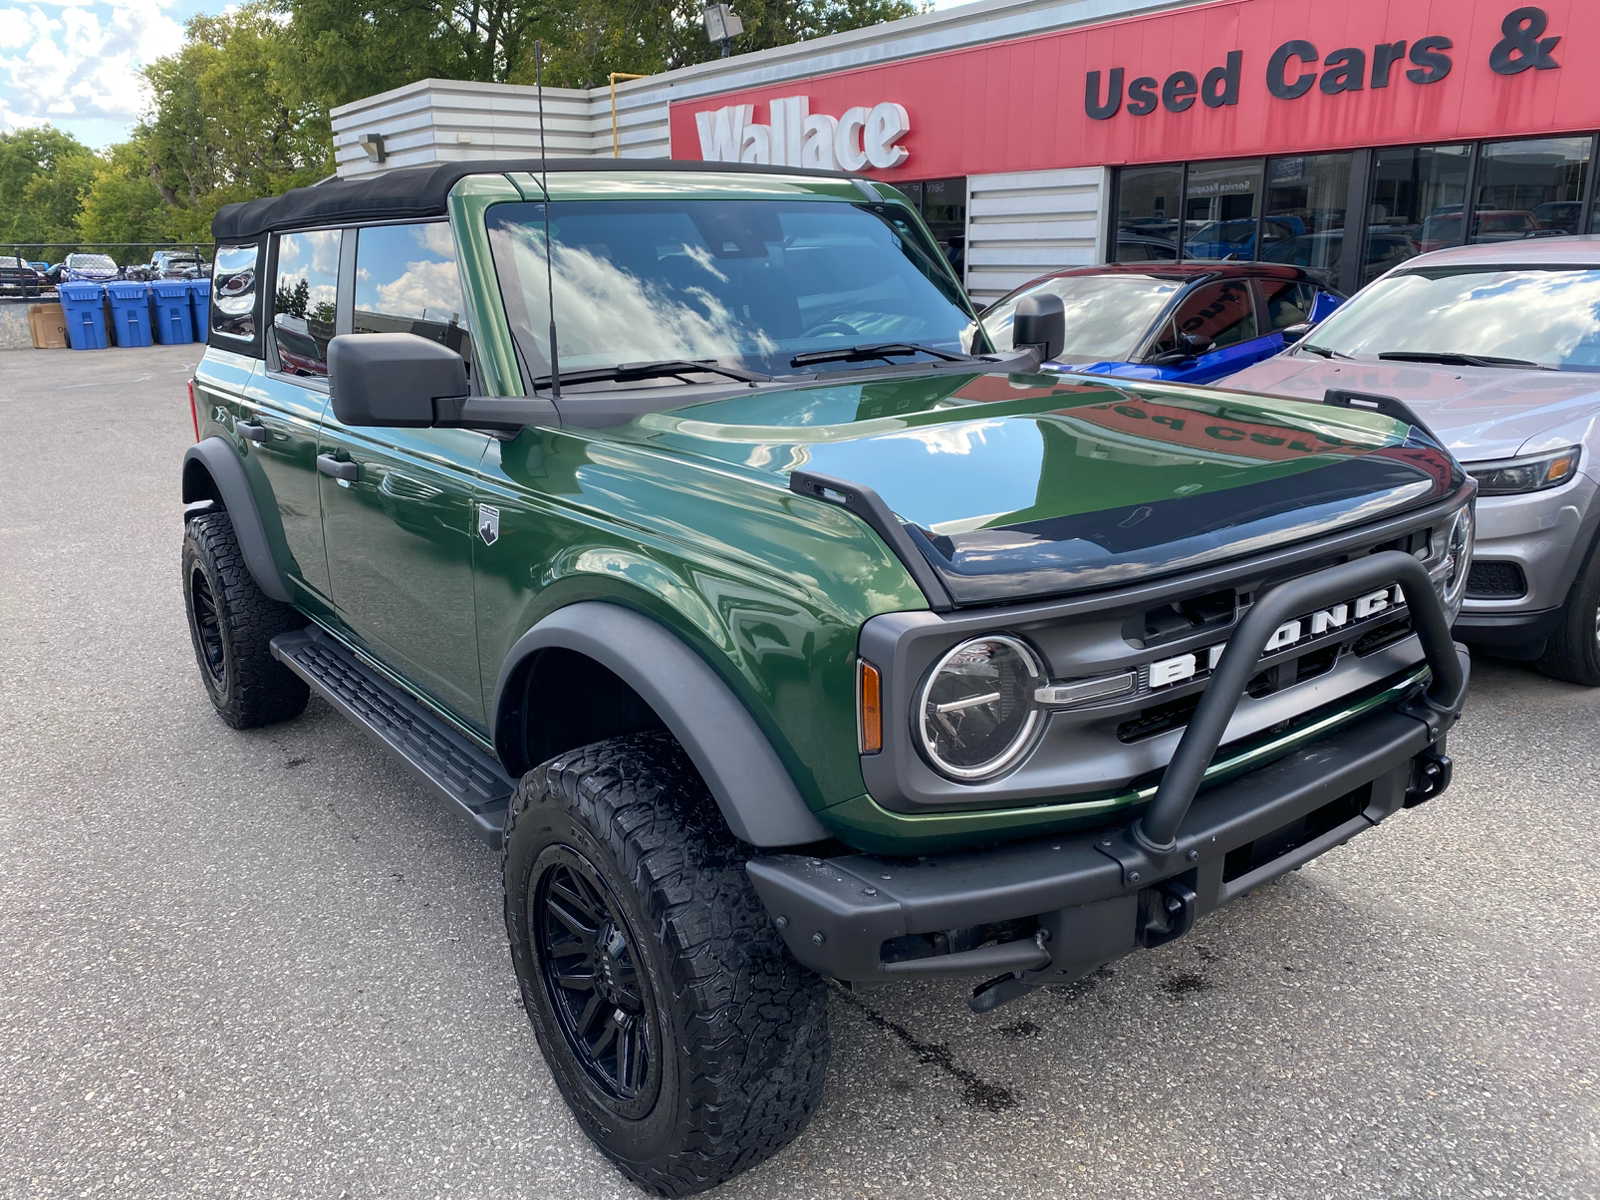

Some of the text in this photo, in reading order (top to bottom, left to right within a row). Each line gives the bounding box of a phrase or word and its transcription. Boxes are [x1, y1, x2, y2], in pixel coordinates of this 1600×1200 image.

[1084, 6, 1562, 121] Used Cars &
[695, 95, 910, 172] Wallace
